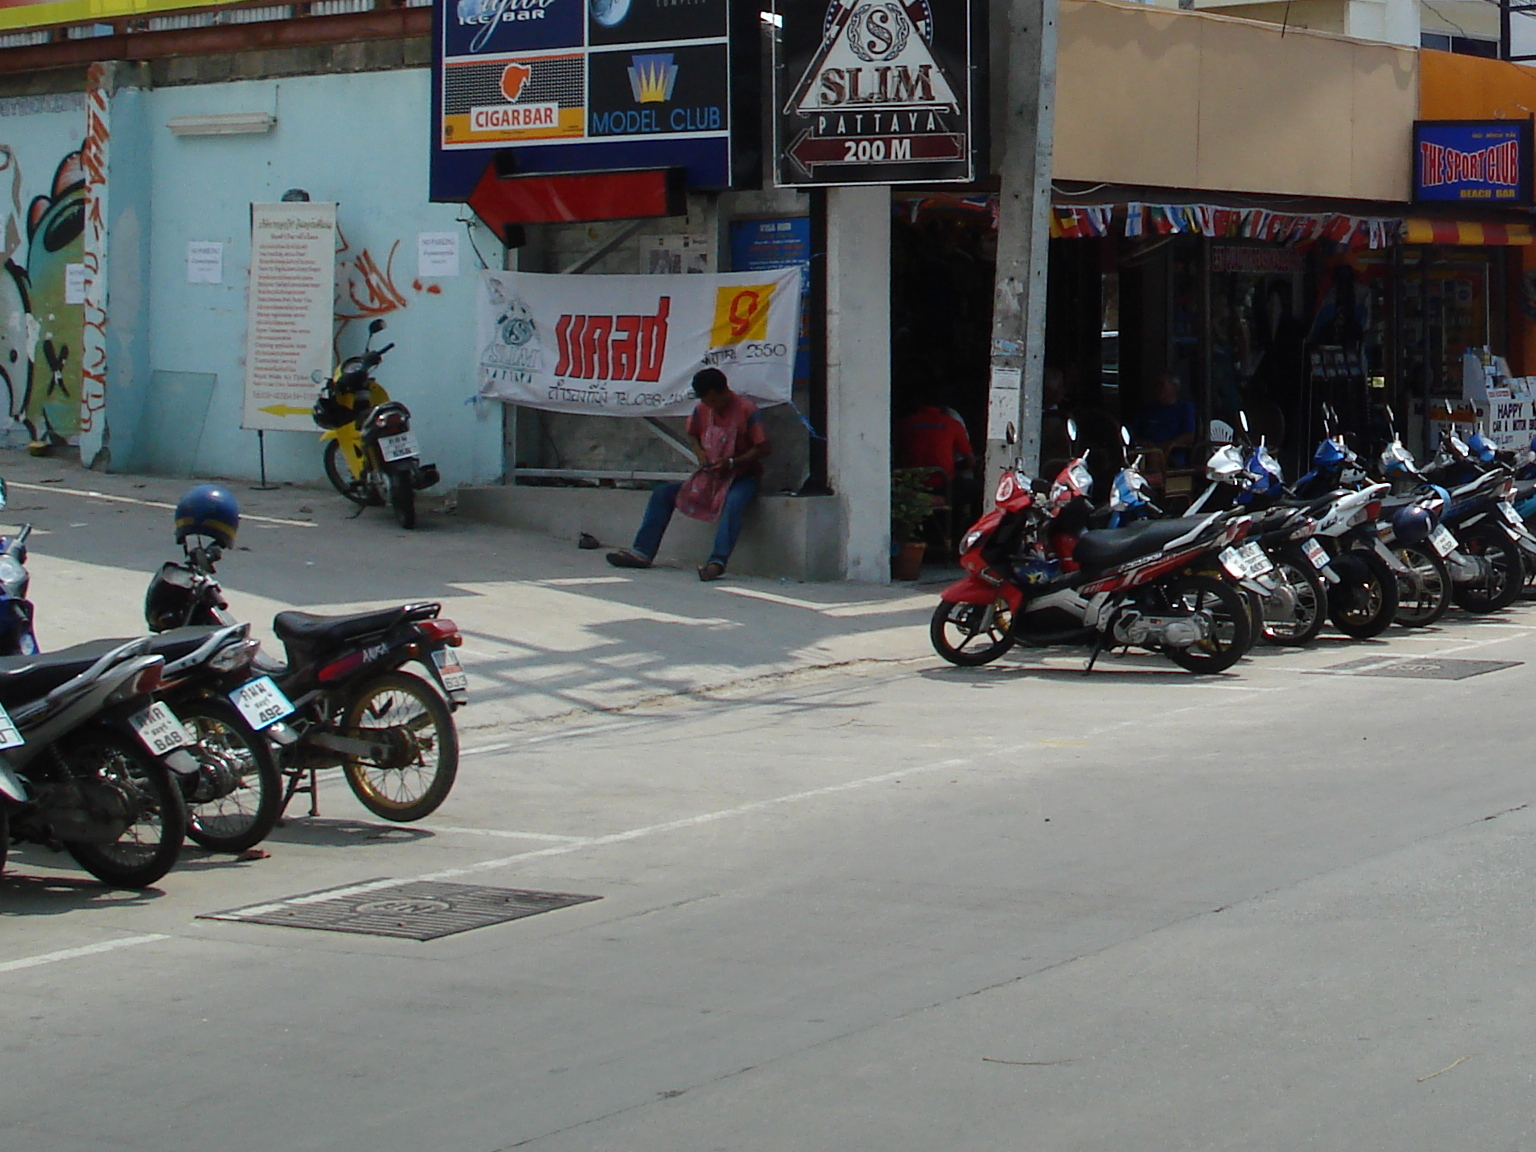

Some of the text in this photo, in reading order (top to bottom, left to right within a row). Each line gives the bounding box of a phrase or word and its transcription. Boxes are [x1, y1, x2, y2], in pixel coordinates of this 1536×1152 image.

[818, 64, 935, 105] SLIM
[592, 106, 721, 134] MODEL CLUB
[818, 114, 937, 136] PATTAYA
[844, 139, 911, 163] 200 M
[1421, 140, 1520, 188] THE SPORT CLUB
[1460, 188, 1492, 199] BEACH
[1497, 402, 1523, 420] HAPPY
[259, 704, 284, 723] 492
